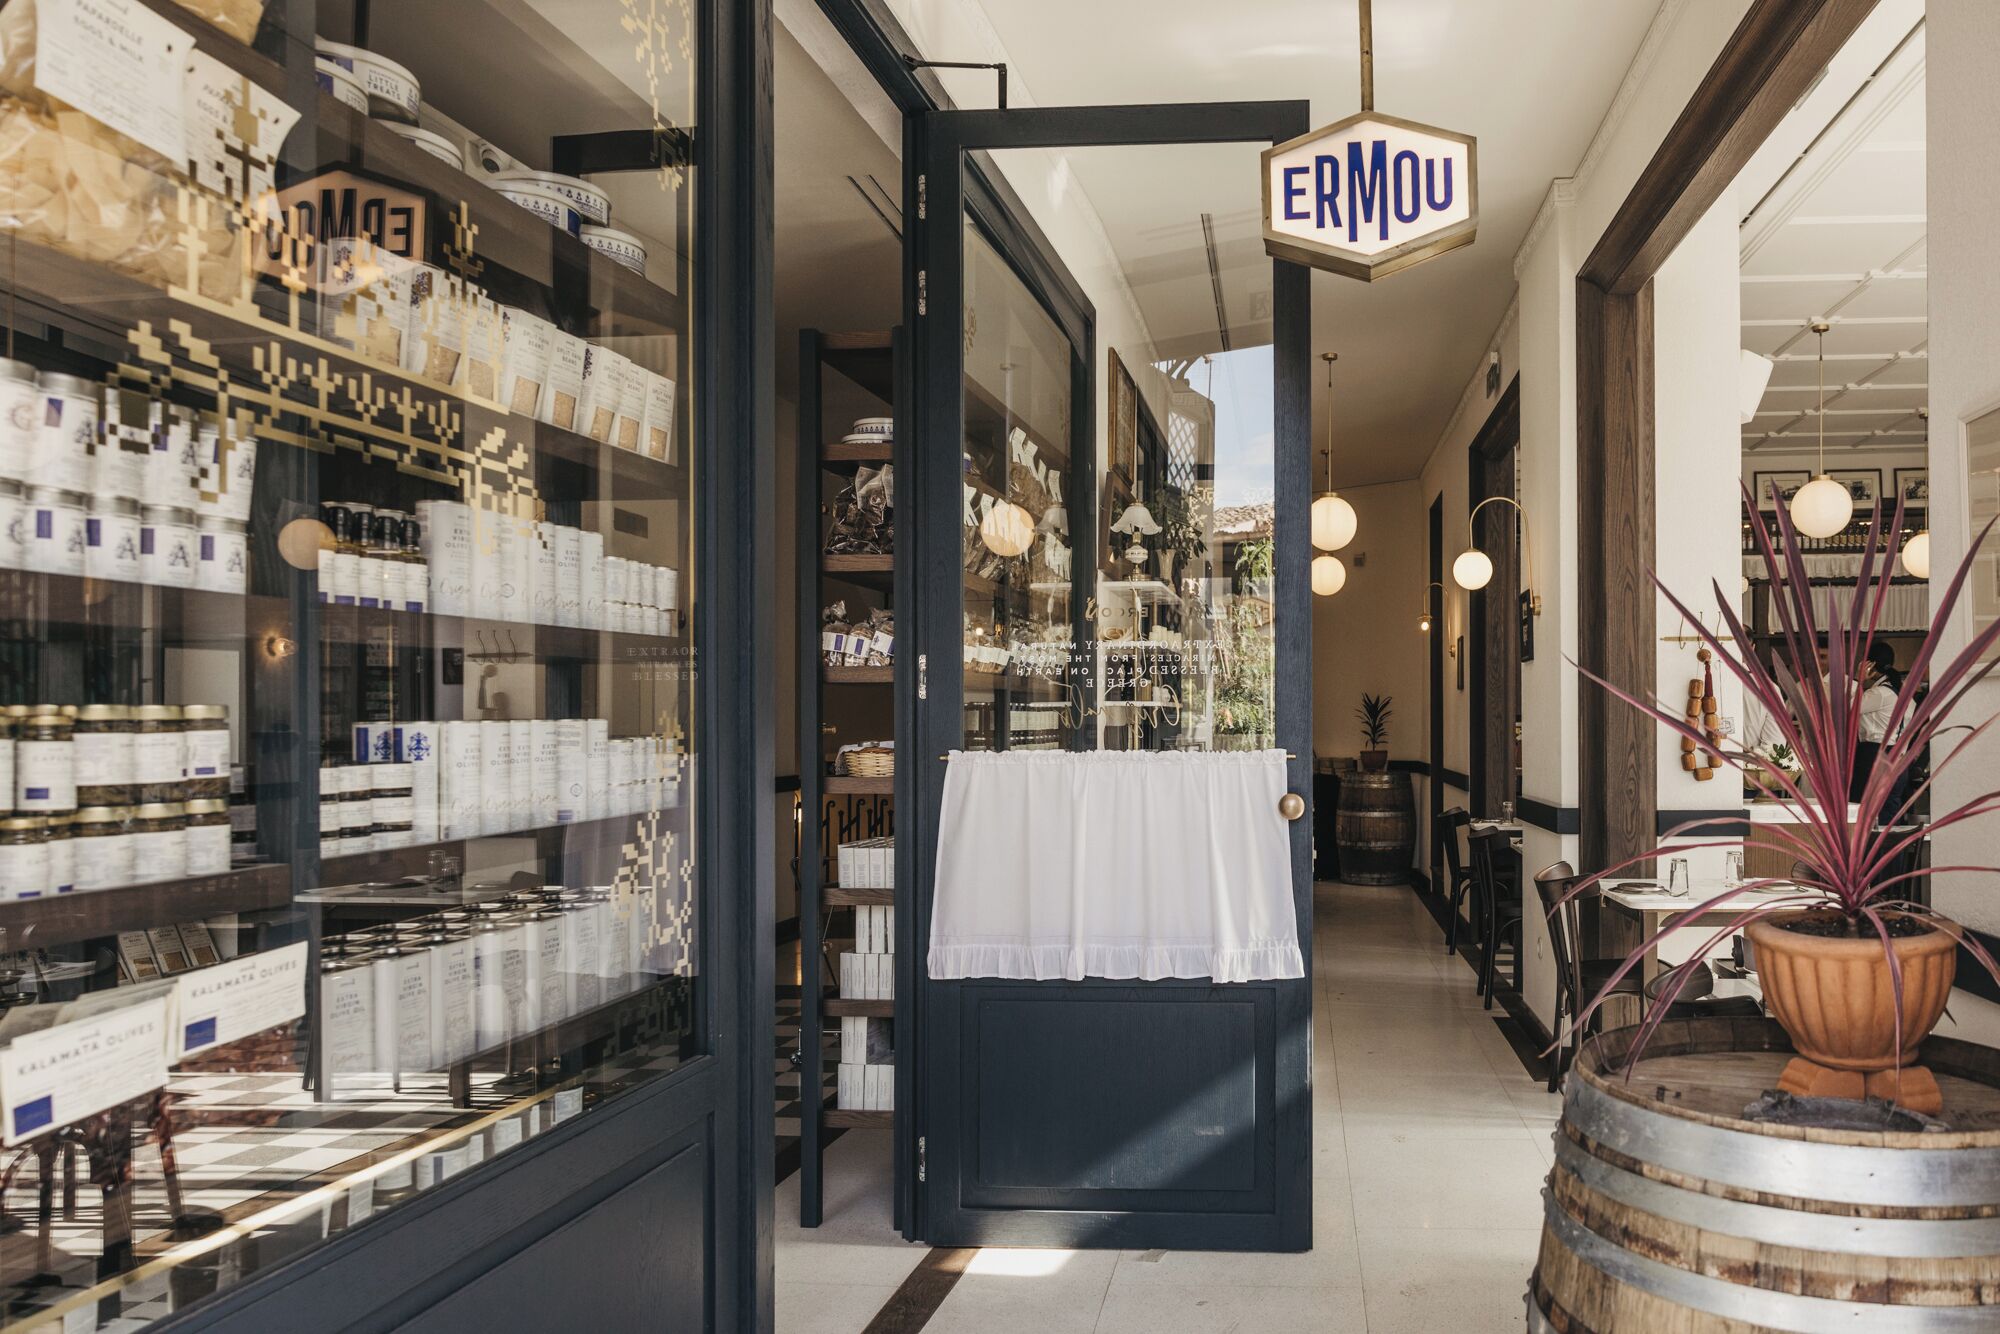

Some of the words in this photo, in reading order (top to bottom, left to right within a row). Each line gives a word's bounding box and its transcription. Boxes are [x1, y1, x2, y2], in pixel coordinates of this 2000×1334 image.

[368, 74, 400, 91] LITTLE
[1284, 140, 1453, 242] ERMOU
[632, 671, 699, 681] BLESSED
[191, 973, 255, 998] KALAMATA
[260, 960, 298, 978] OLIVES
[18, 1042, 100, 1076] KALAMATA
[106, 1022, 156, 1047] OLIVES
